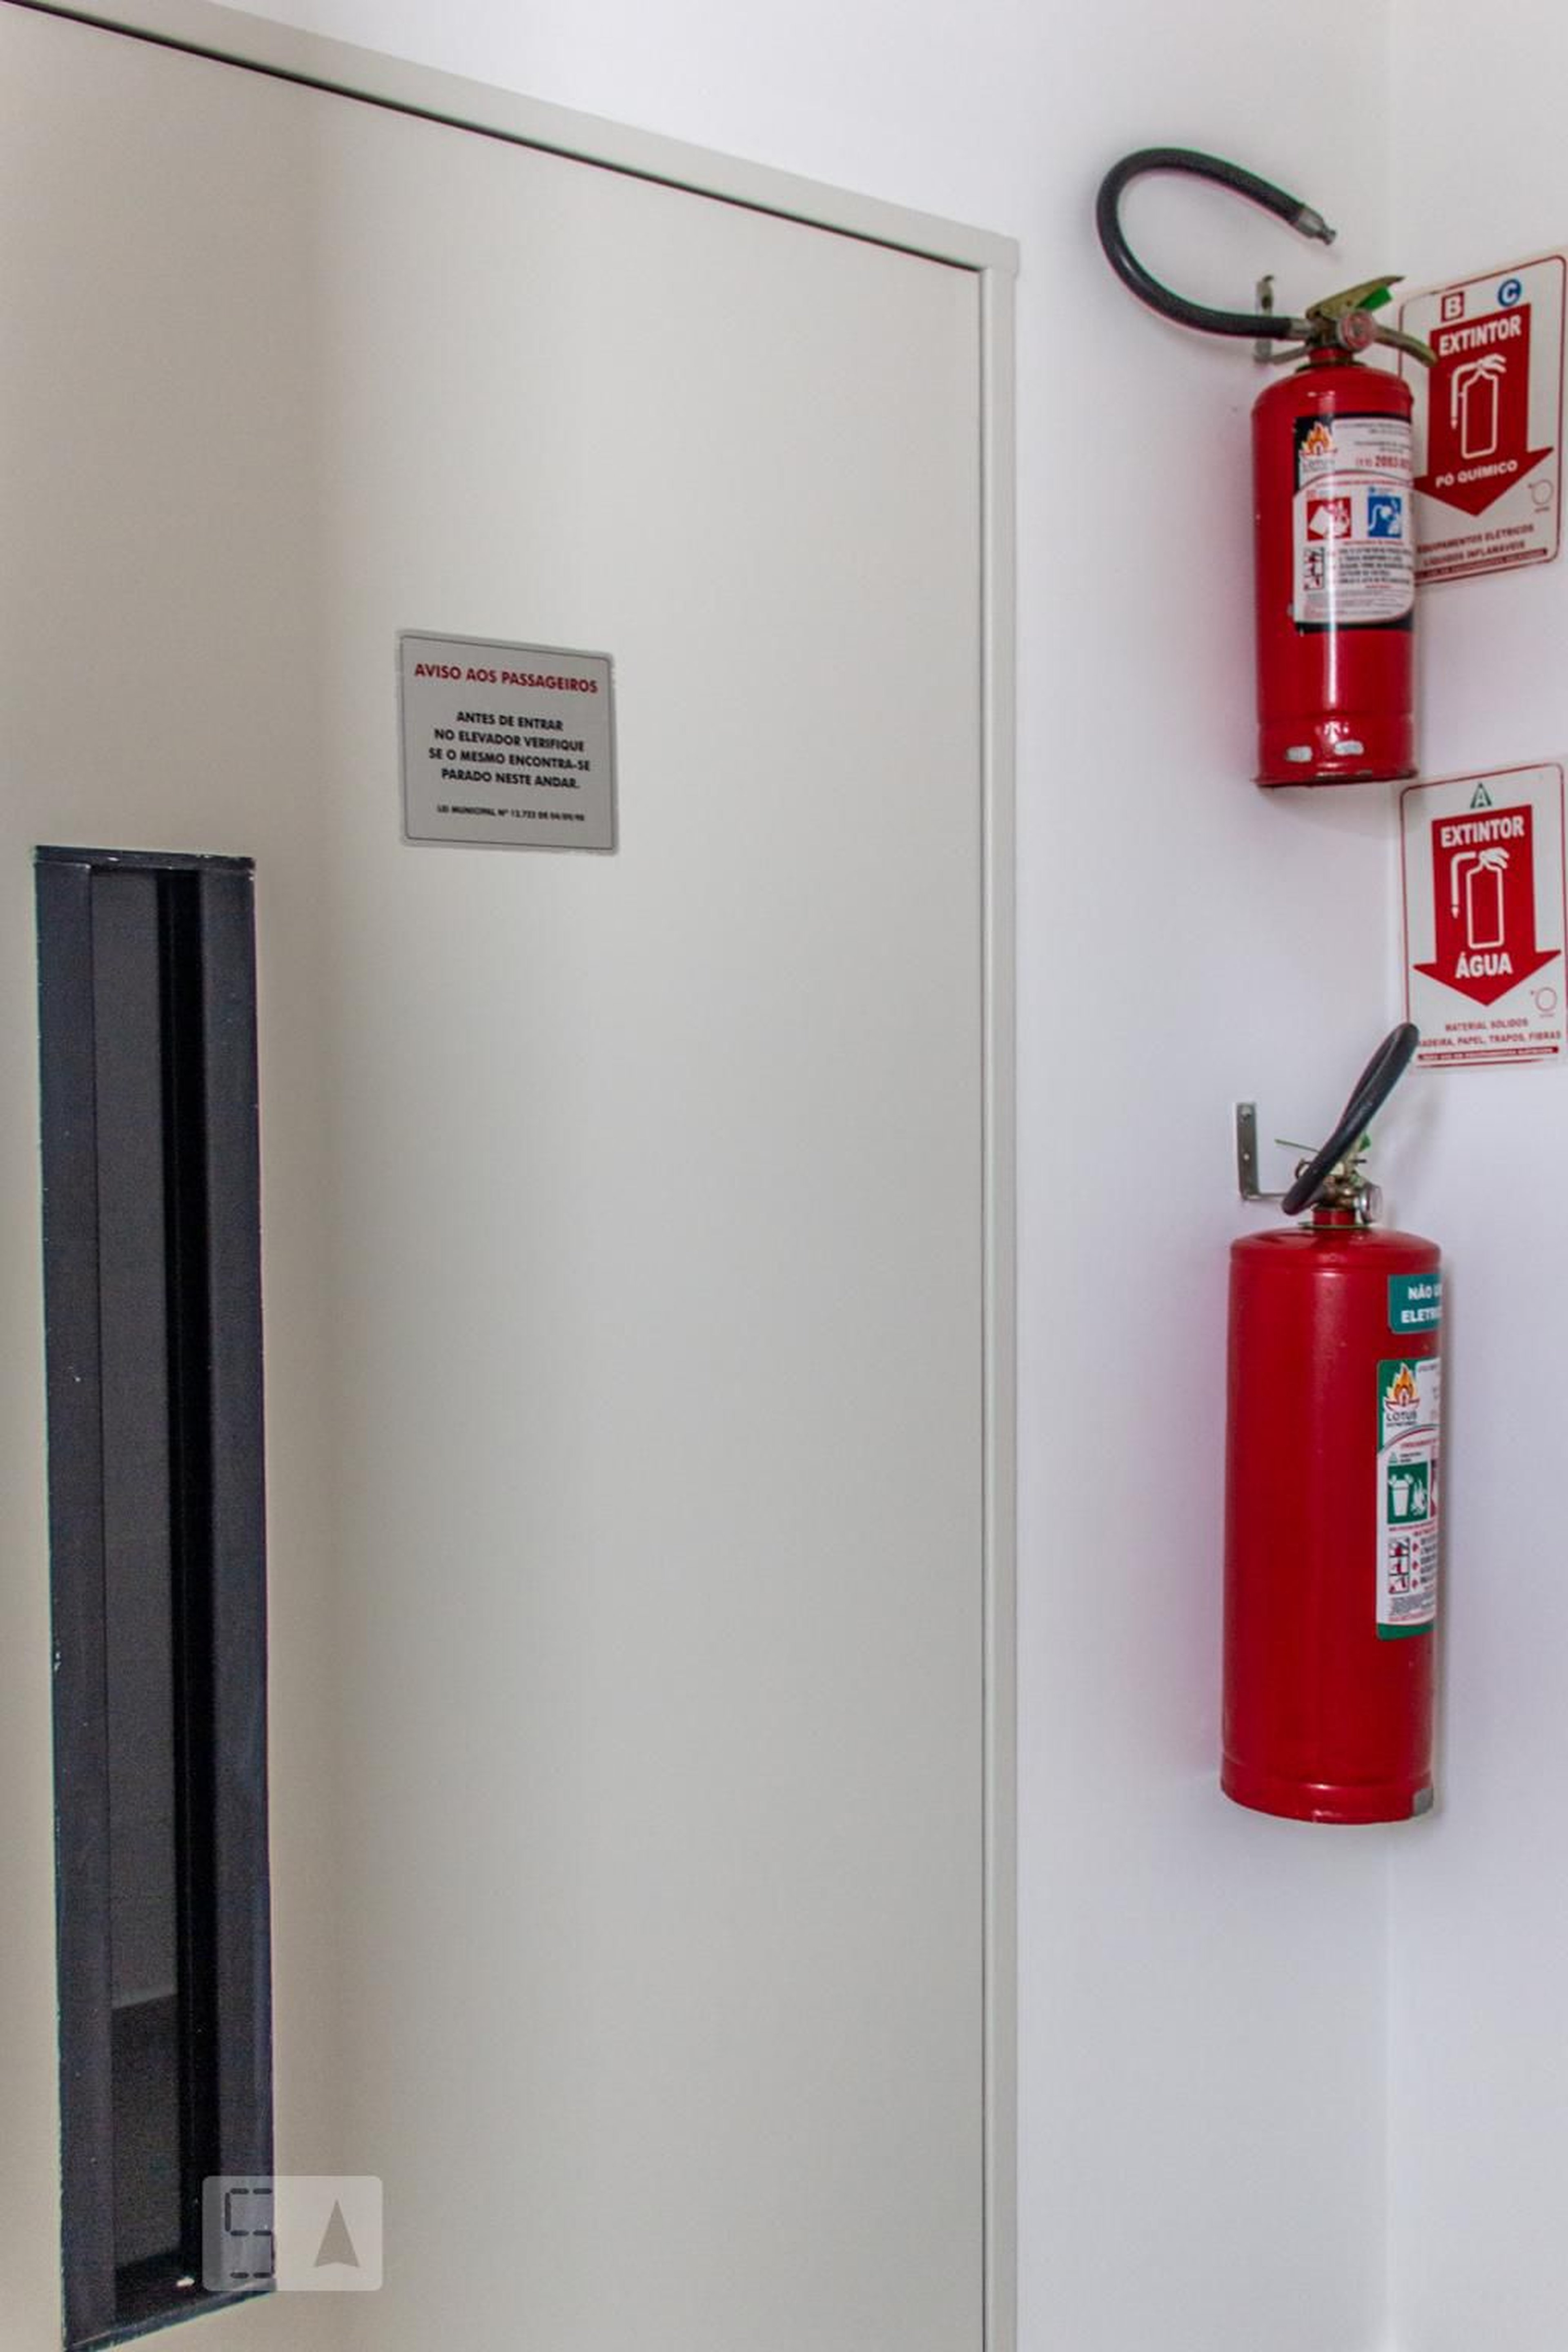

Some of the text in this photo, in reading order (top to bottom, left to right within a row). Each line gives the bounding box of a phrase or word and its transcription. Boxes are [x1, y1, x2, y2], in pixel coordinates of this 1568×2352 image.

[1445, 294, 1461, 321] B
[1439, 315, 1521, 356] EXTINTOR
[1435, 459, 1518, 488] PÓ QUÍMICO
[1484, 523, 1534, 541] ELÉTRICOS
[415, 663, 598, 693] AVISO AOS PASSAGEIROS
[457, 711, 564, 731] ANTES DE ENTRAR
[434, 728, 584, 752] NO ELEVADOR VERIFIQUE
[429, 747, 590, 772] SE O MESMO ENCONTRA-SE
[441, 768, 580, 789] PARADO NESTE ANDAR.
[1473, 786, 1490, 808] A
[451, 805, 496, 816] MUNICIPAL
[1441, 815, 1525, 848] EXTINTOR
[1454, 951, 1513, 979] ÁGUA
[1445, 1021, 1486, 1032] MATERIAL
[1529, 1029, 1561, 1040] FIBRAS
[1408, 1283, 1432, 1300] NÃO
[1386, 1411, 1417, 1422] LOTUS
